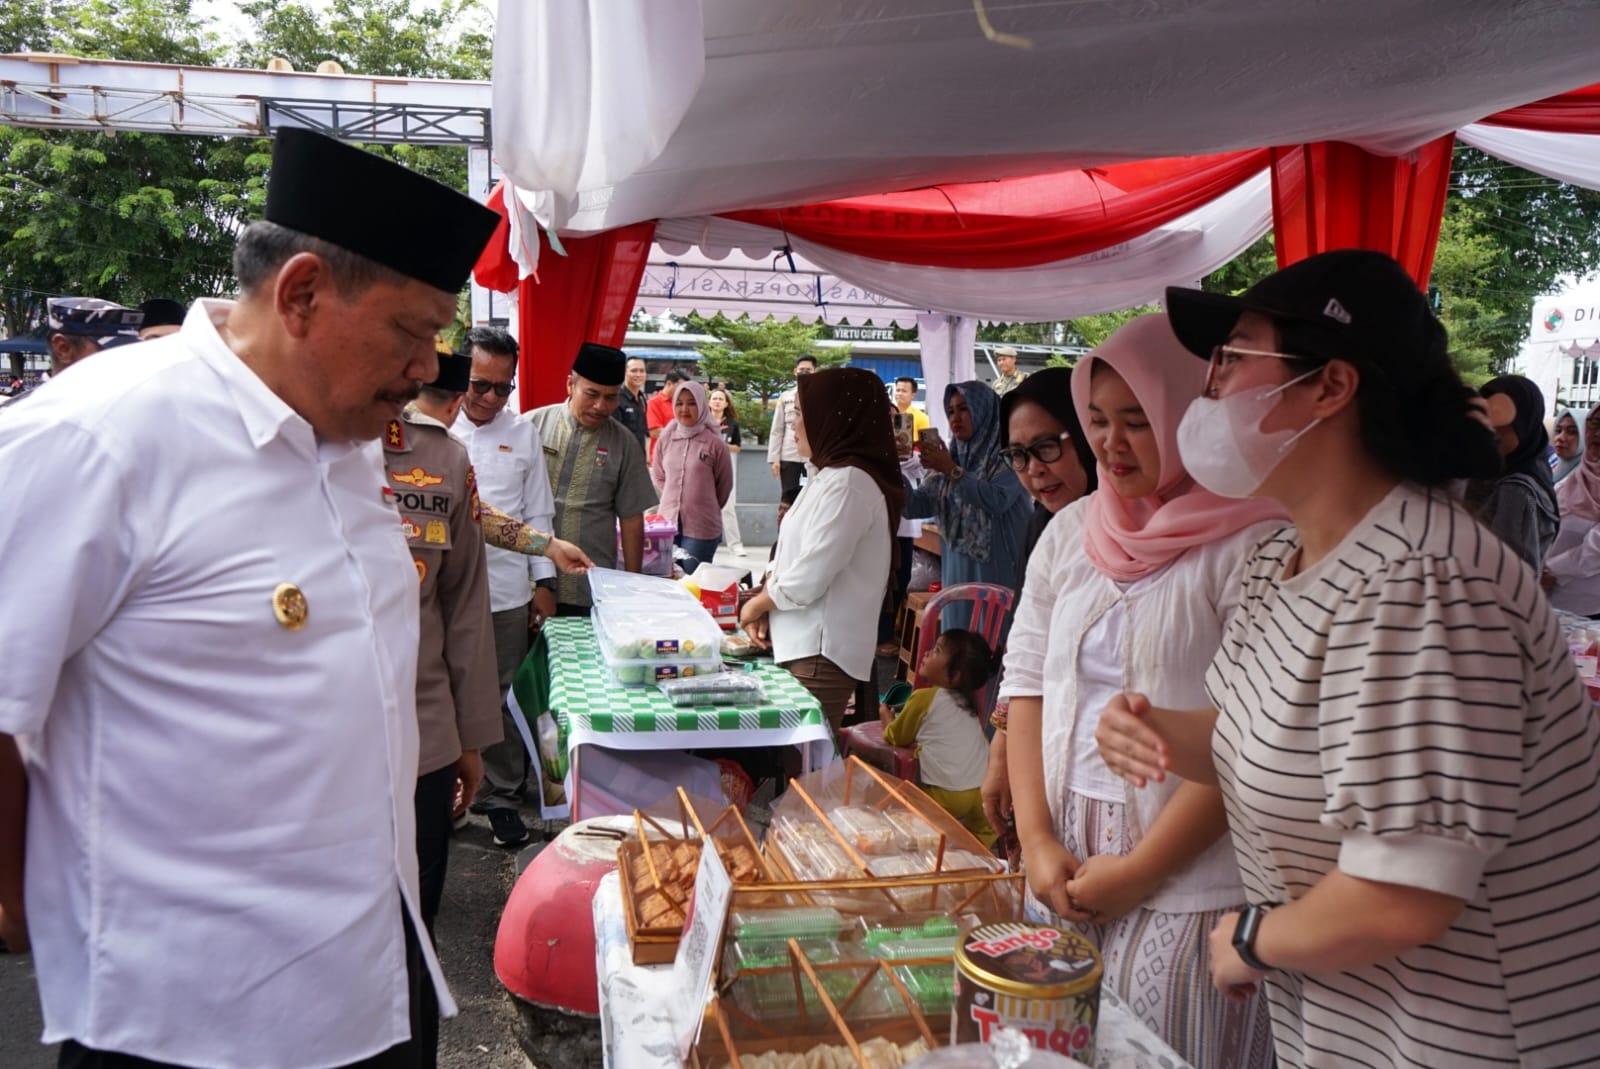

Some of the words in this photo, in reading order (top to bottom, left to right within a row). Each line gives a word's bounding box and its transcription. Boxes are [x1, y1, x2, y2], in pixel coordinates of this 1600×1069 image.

[1574, 307, 1600, 322] DI
[834, 328, 860, 339] VIRTU
[860, 329, 894, 340] COFFEE
[393, 493, 449, 514] POLRI
[966, 928, 1061, 957] Tango
[972, 1006, 1091, 1056] Tngo
